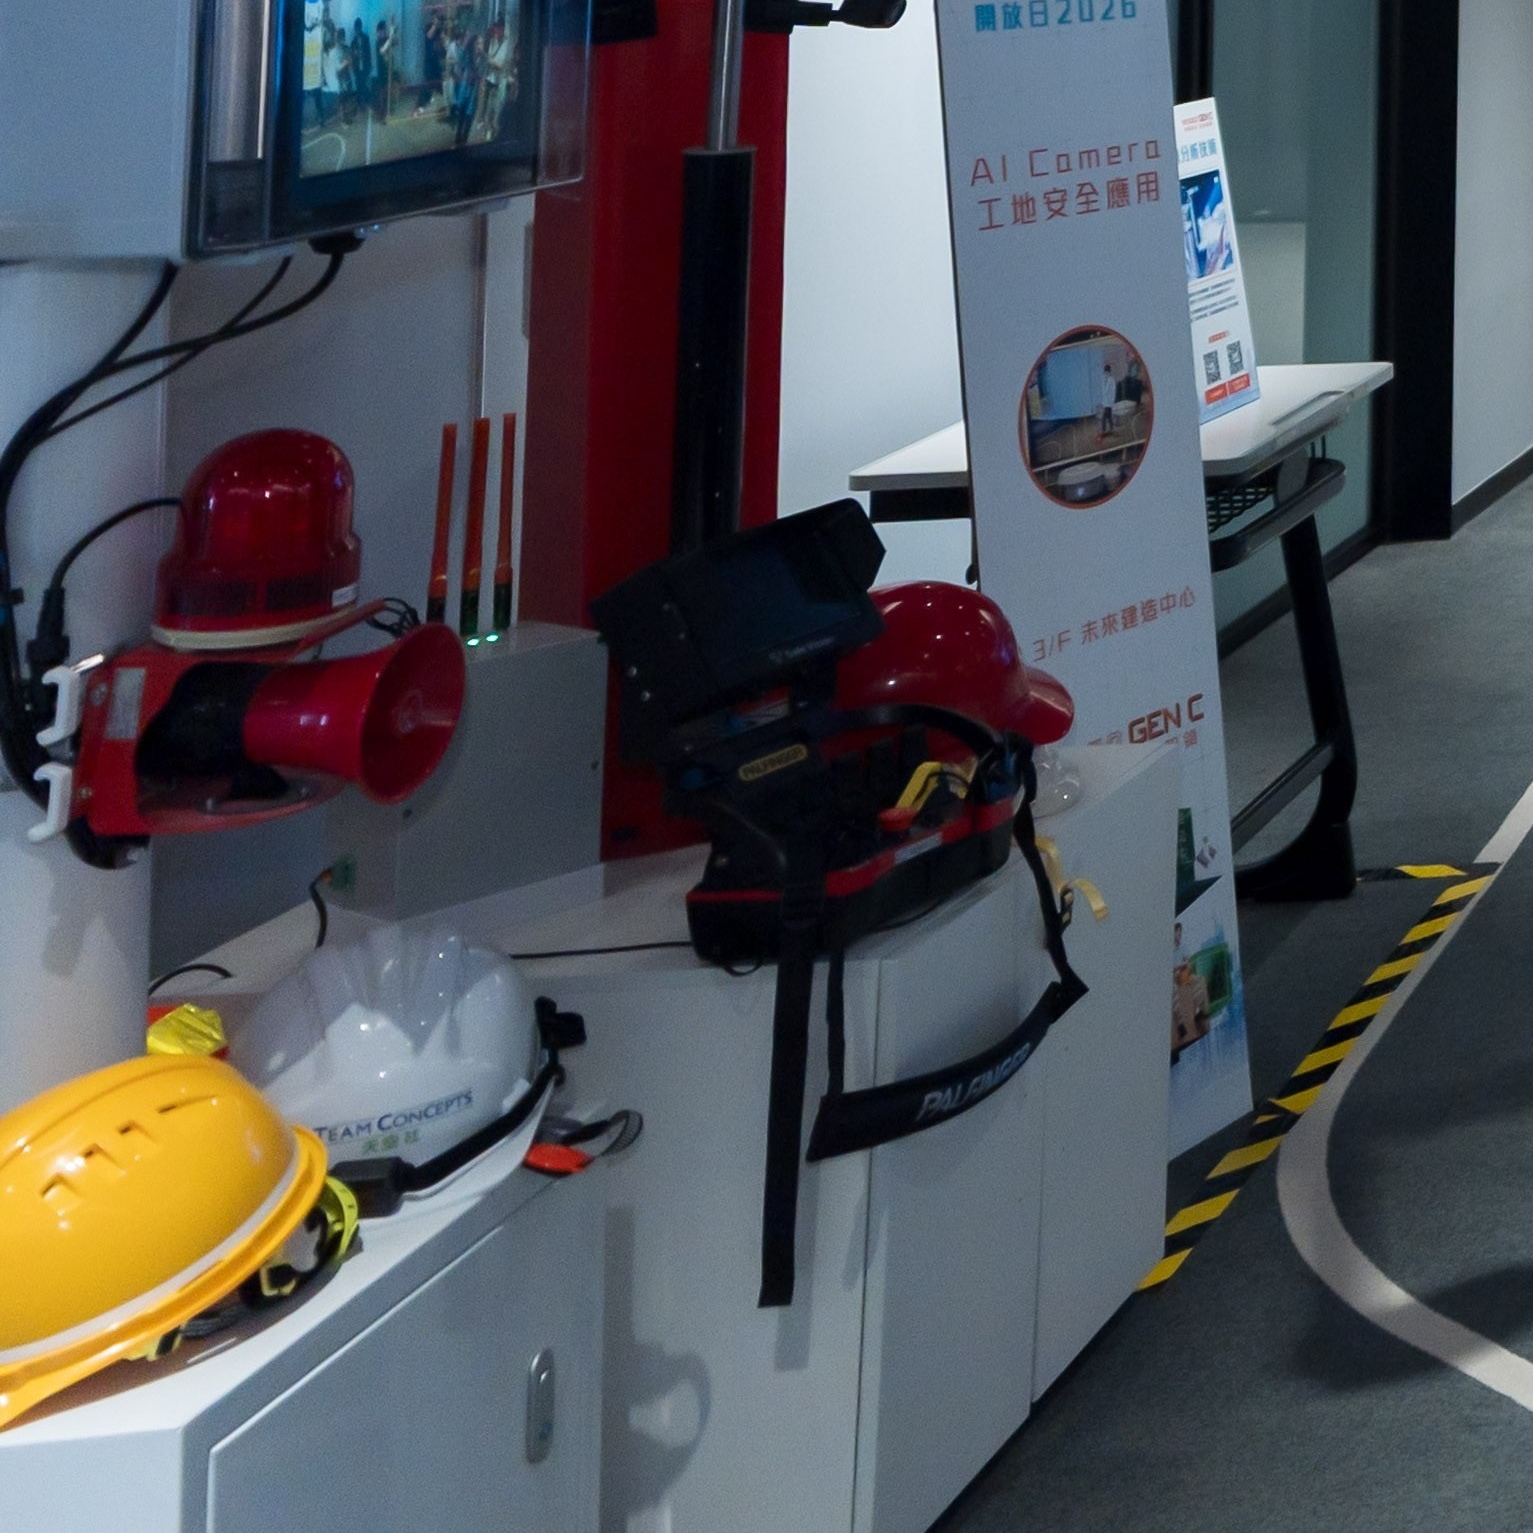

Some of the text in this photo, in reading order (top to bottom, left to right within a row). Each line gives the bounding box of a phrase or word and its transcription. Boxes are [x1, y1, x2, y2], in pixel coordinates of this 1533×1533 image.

[970, 140, 1161, 187] AI Camera
[977, 171, 1161, 231] 工地安全應用
[1032, 585, 1196, 663] 3/F 未來建造中心
[1128, 702, 1182, 745] GEN
[1187, 693, 1205, 723] C
[313, 1120, 372, 1142] TEAM
[377, 1088, 474, 1132] CONCEPTS
